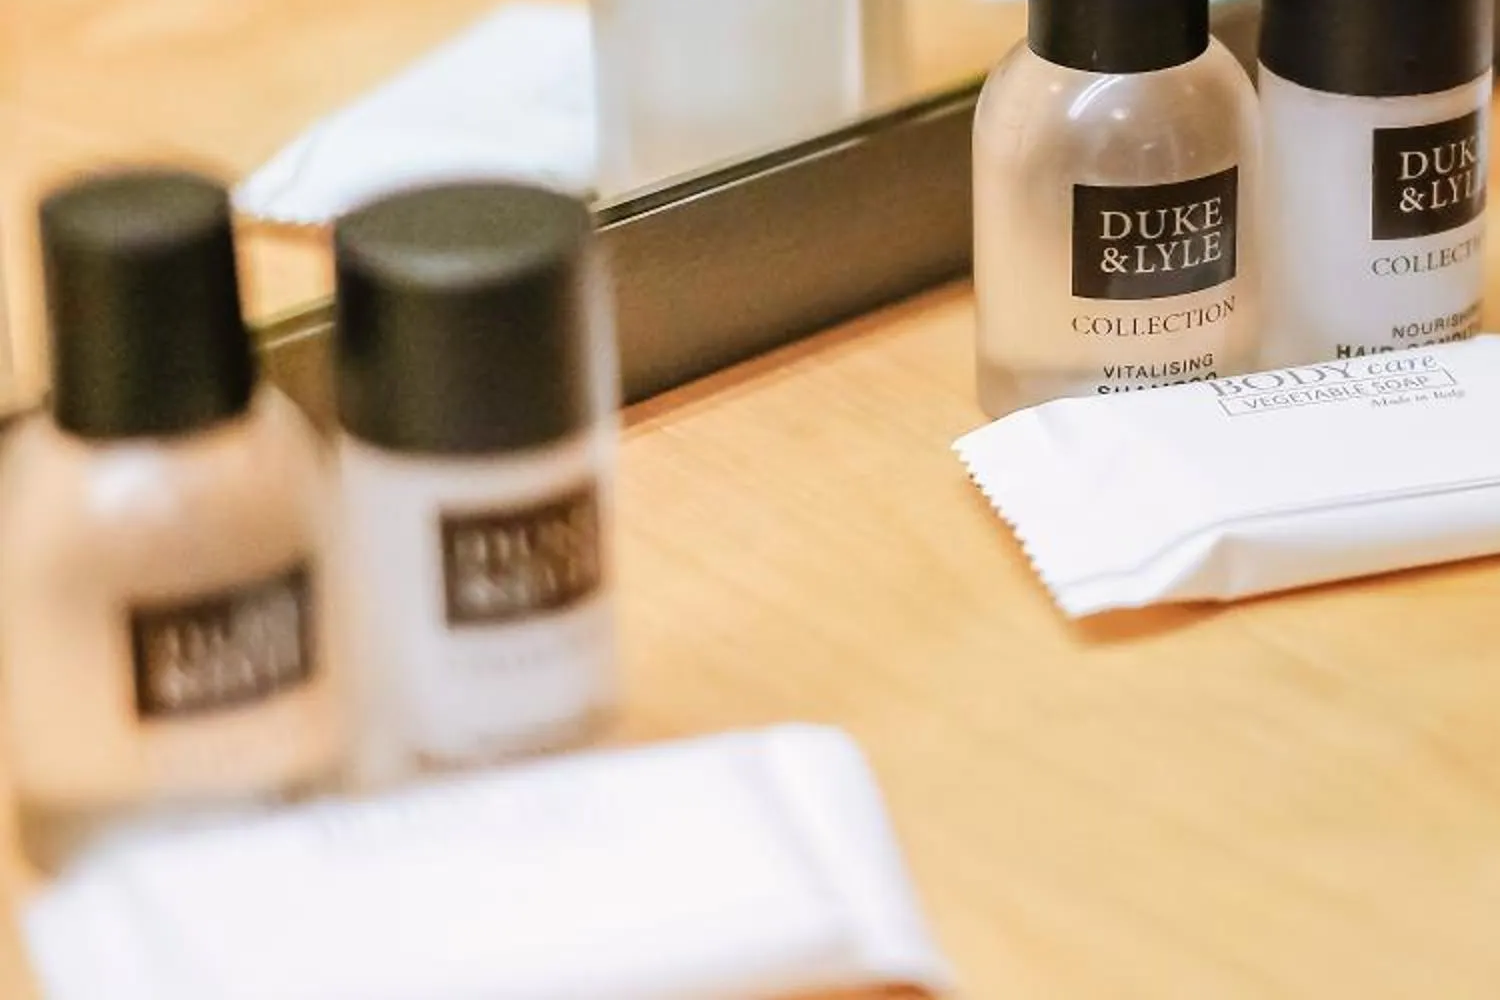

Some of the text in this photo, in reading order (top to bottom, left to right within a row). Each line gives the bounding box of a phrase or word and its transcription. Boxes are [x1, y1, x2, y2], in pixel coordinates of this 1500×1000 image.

[1399, 136, 1477, 180] DUK
[1100, 197, 1223, 240] DUKE
[1371, 235, 1481, 276] COLLECT
[1071, 295, 1236, 337] COLLECTION
[1103, 353, 1213, 379] VITALISING
[1208, 362, 1354, 397] BODY
[1367, 355, 1437, 375] care
[1243, 383, 1366, 409] VEGETABLE
[1371, 376, 1428, 394] SOAP
